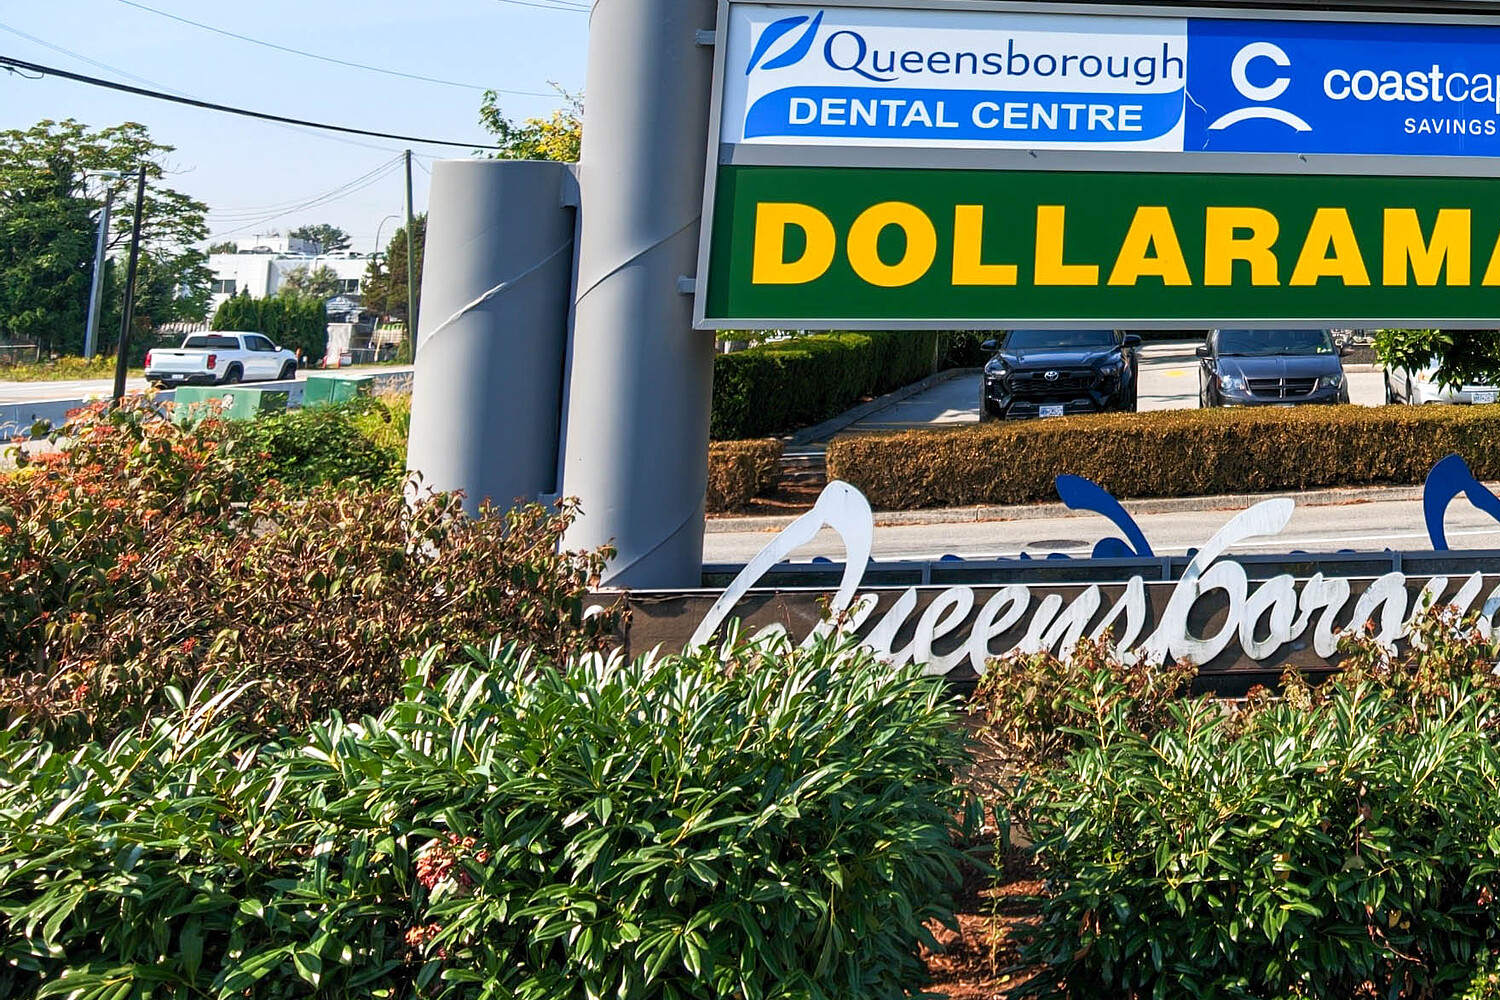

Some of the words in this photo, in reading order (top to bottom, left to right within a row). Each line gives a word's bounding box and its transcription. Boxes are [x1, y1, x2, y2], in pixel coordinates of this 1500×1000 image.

[825, 30, 1184, 86] Queensborough
[788, 97, 959, 128] DENTAL
[972, 101, 1143, 132] CENTRE
[1404, 117, 1497, 136] SAVINGS
